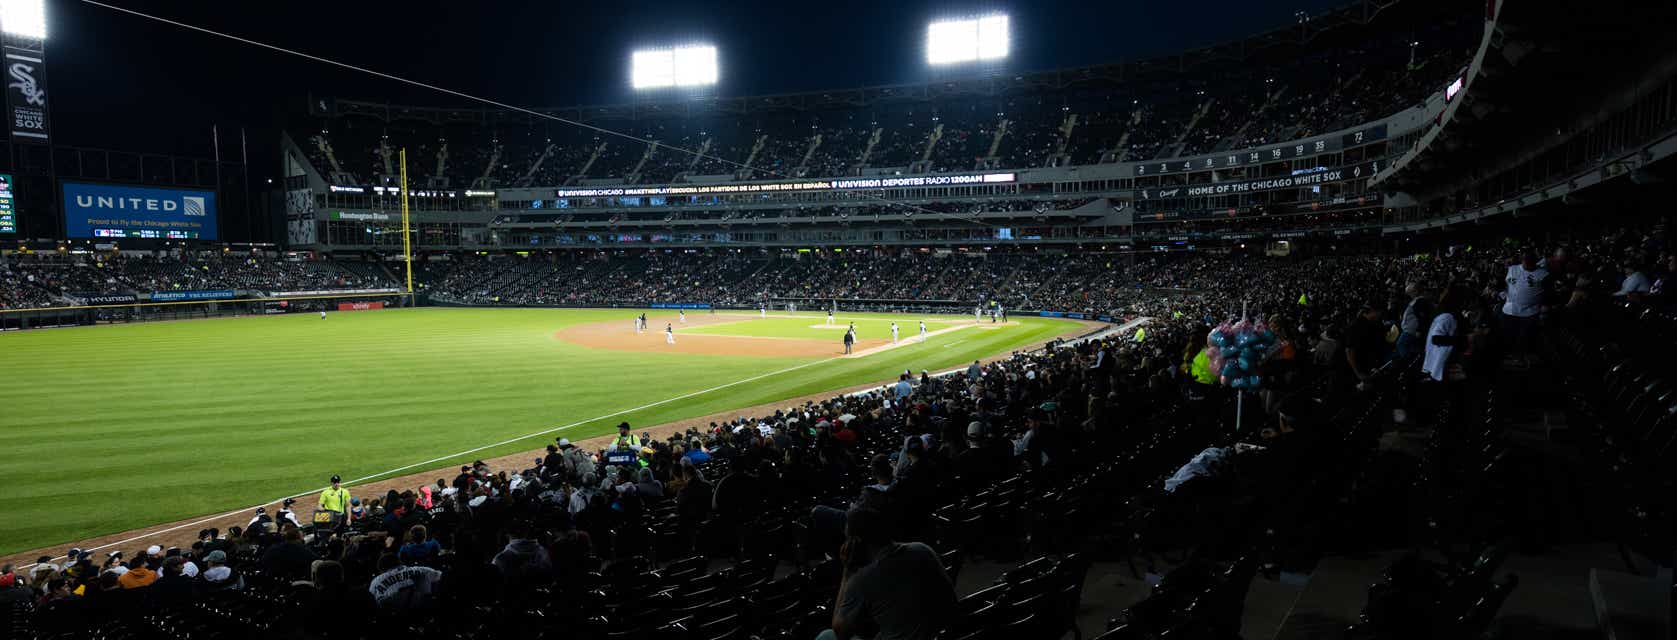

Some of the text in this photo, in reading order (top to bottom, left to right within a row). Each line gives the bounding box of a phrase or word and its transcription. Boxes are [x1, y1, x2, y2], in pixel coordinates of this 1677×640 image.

[16, 120, 44, 130] SOX
[1316, 141, 1324, 150] 35
[839, 180, 881, 188] UNIVISION
[882, 178, 925, 186] DEPORTES
[1188, 186, 1214, 196] HOME
[1232, 183, 1248, 191] THE
[1252, 178, 1292, 190] CHICAGO
[1294, 174, 1320, 184] WHITE
[1324, 171, 1342, 181] SOX
[76, 195, 178, 211] UNITED
